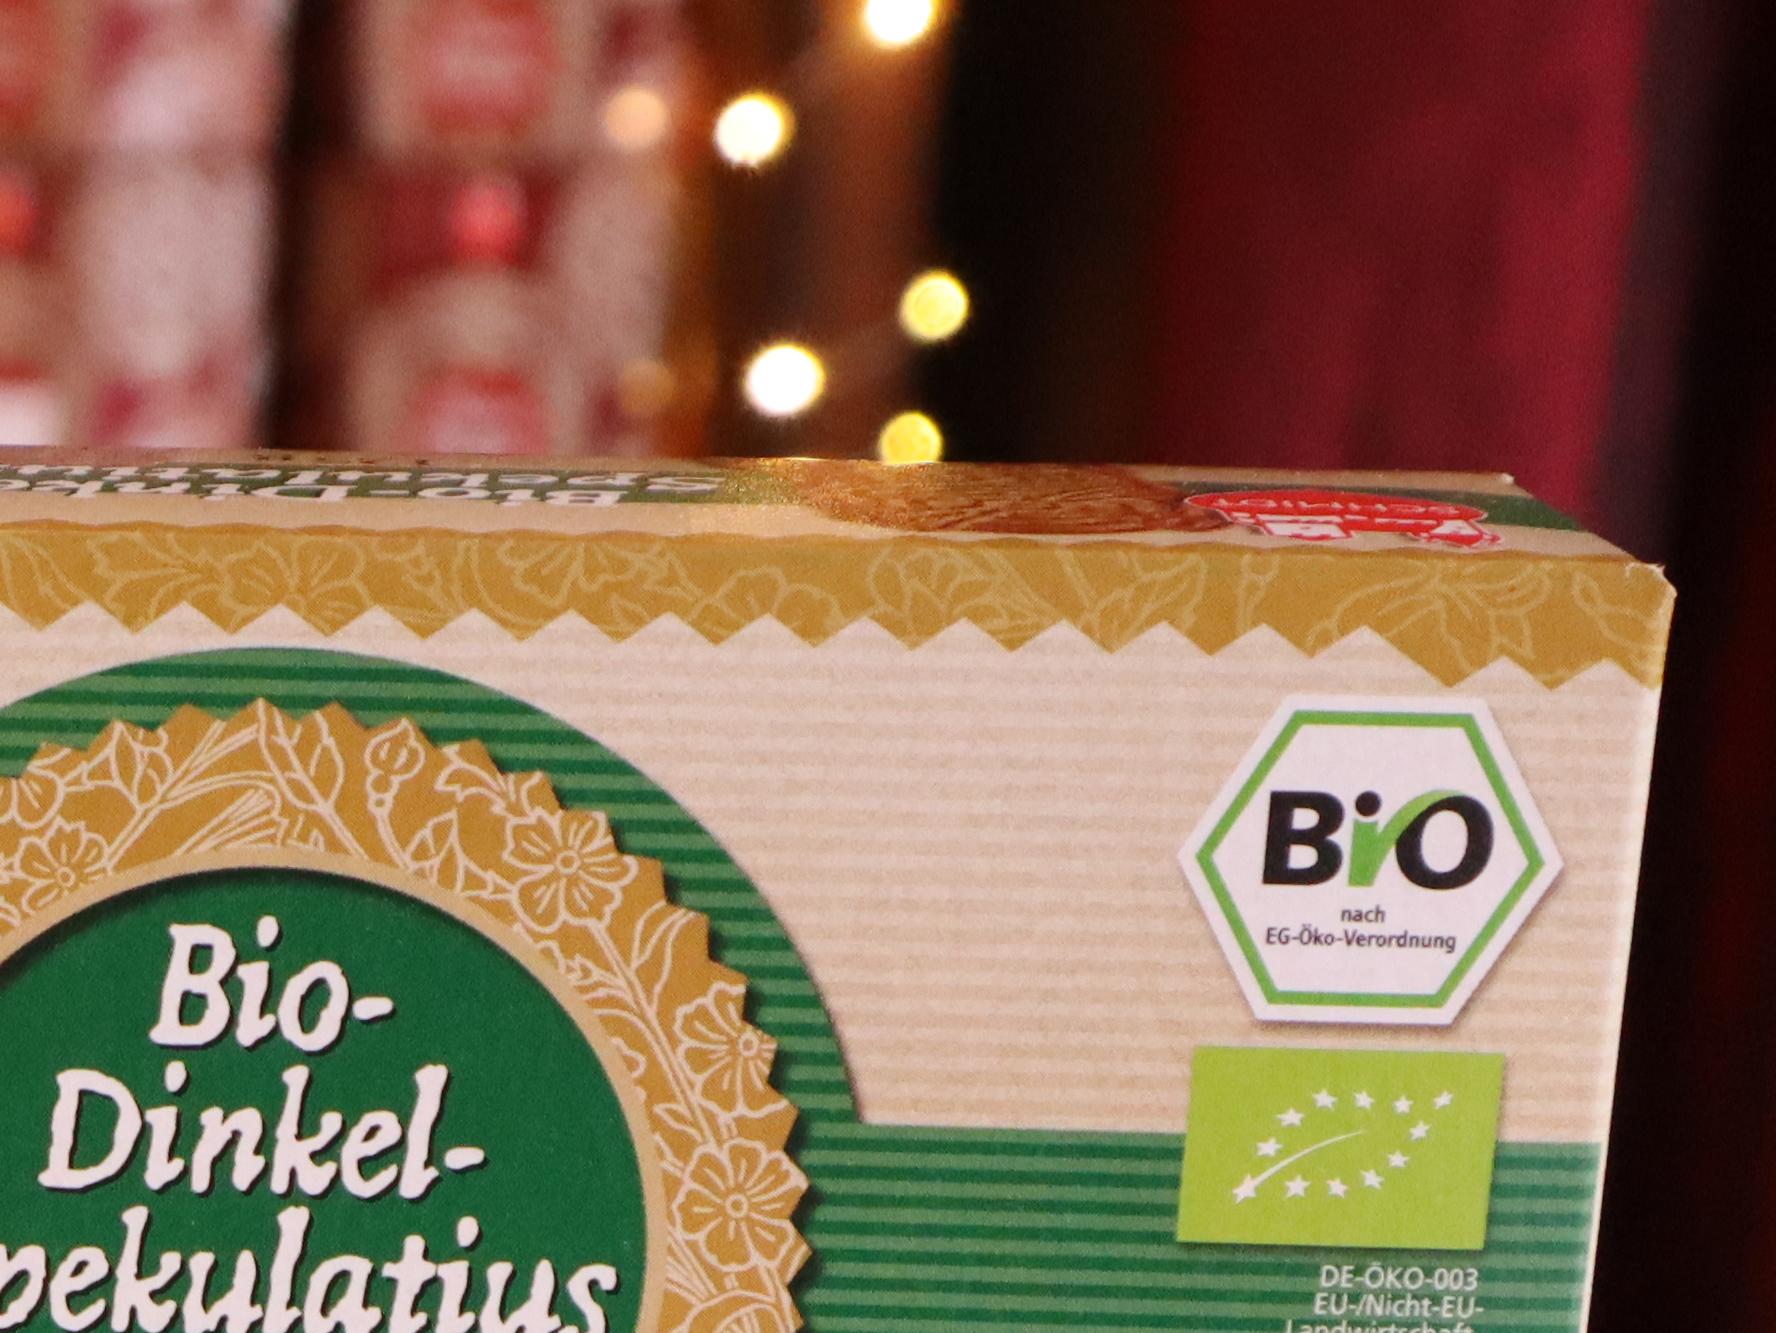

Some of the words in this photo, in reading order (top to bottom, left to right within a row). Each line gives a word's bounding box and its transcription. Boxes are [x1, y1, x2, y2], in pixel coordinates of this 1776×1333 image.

[1340, 904, 1386, 924] nach
[1264, 924, 1457, 954] EG-Öko-Verordnung
[149, 916, 396, 1053] Bio-
[38, 1061, 486, 1199] Dinkel-
[1319, 1261, 1479, 1290] DE-ÖKO-003
[1313, 1290, 1485, 1318] EU-/Nicht-EU-
